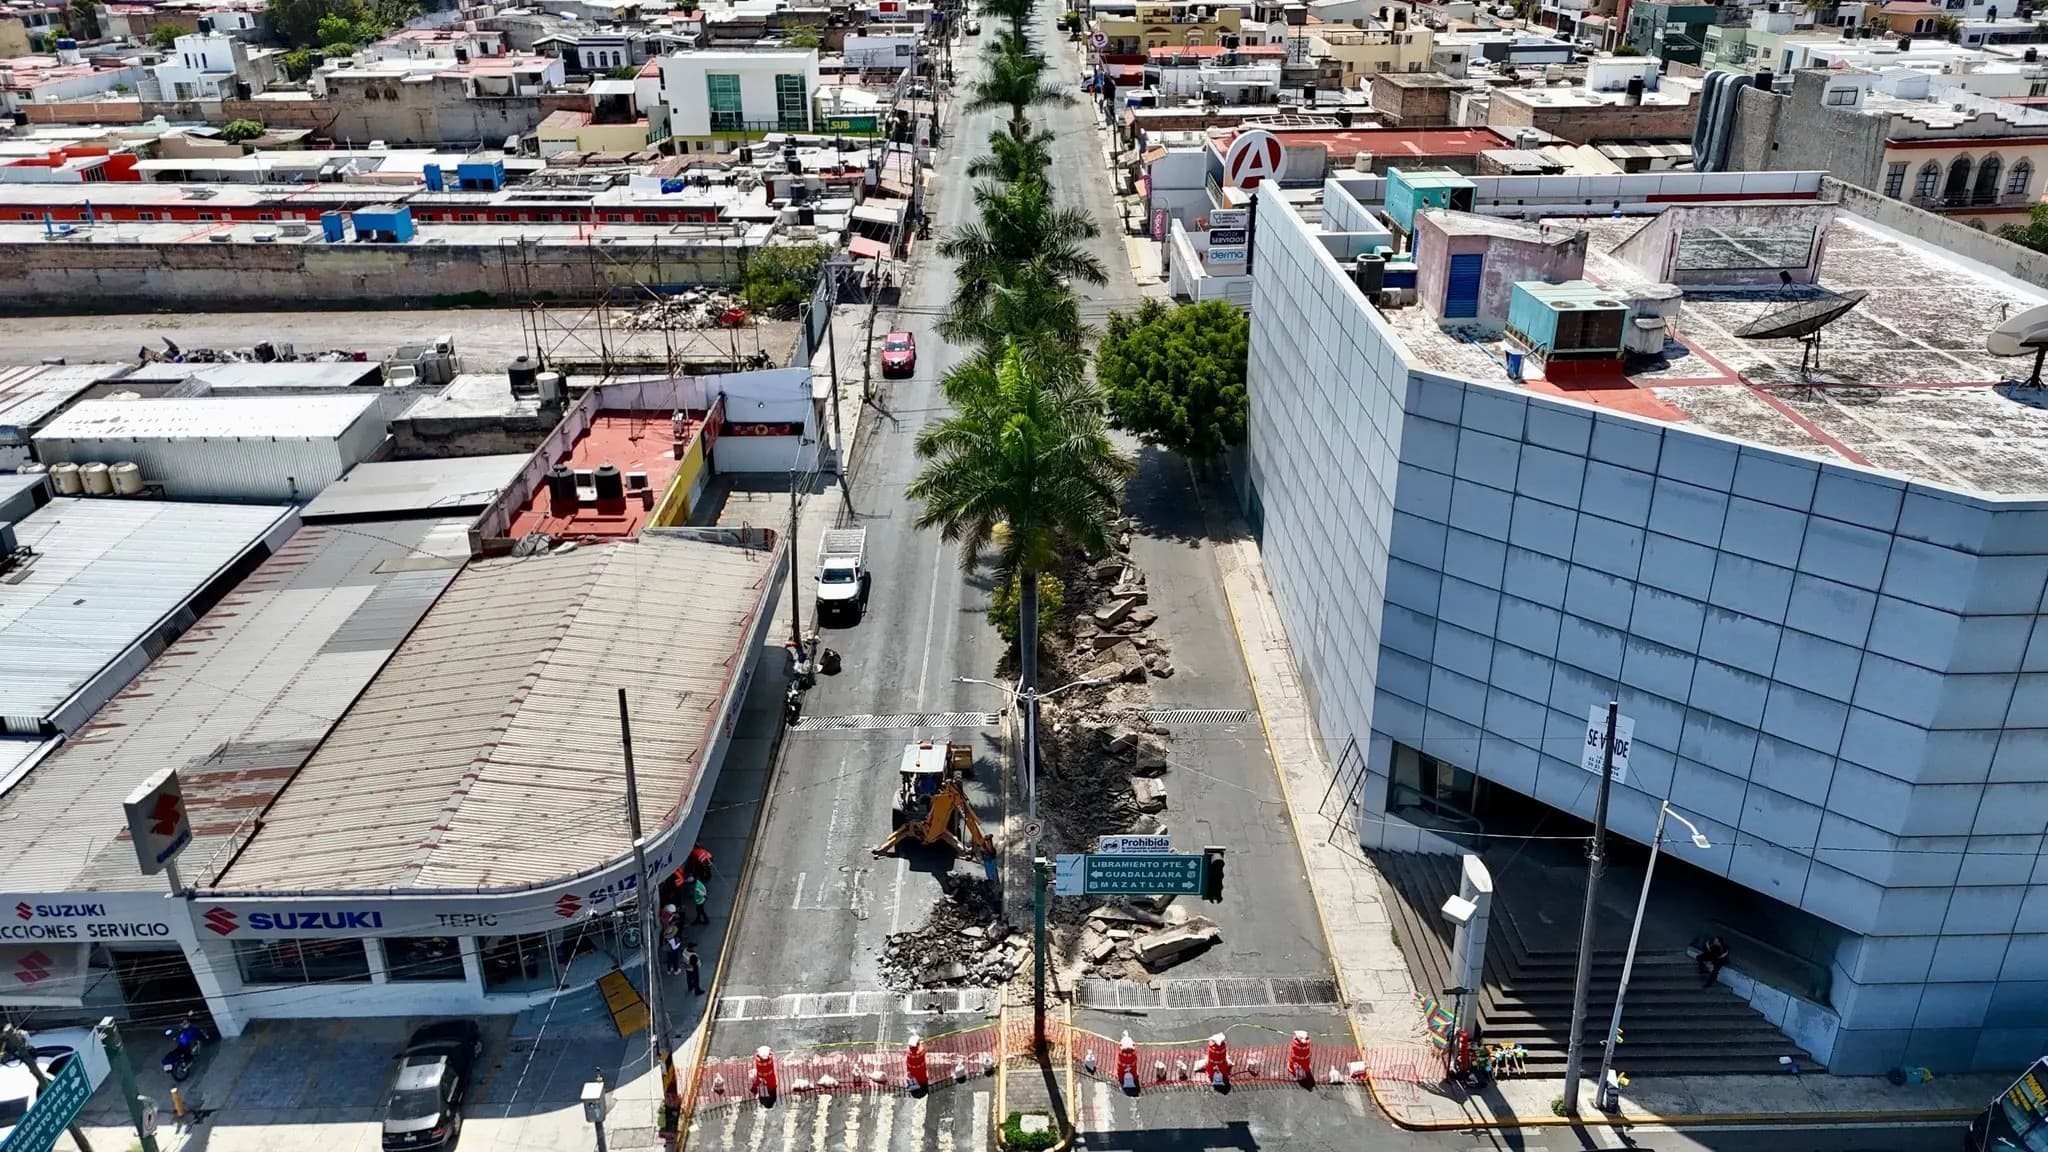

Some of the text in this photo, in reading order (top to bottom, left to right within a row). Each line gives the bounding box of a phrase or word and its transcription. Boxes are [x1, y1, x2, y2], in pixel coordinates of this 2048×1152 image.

[1231, 132, 1279, 191] A
[1210, 251, 1244, 259] derma
[1587, 728, 1630, 758] SE VNDE
[1121, 839, 1170, 847] Prohibida
[36, 904, 106, 917] SUZUKI
[247, 911, 499, 930] SUZUKI TEPIC
[0, 922, 169, 939] CCIONES SERVICIO
[49, 1087, 85, 1133] CENTRO
